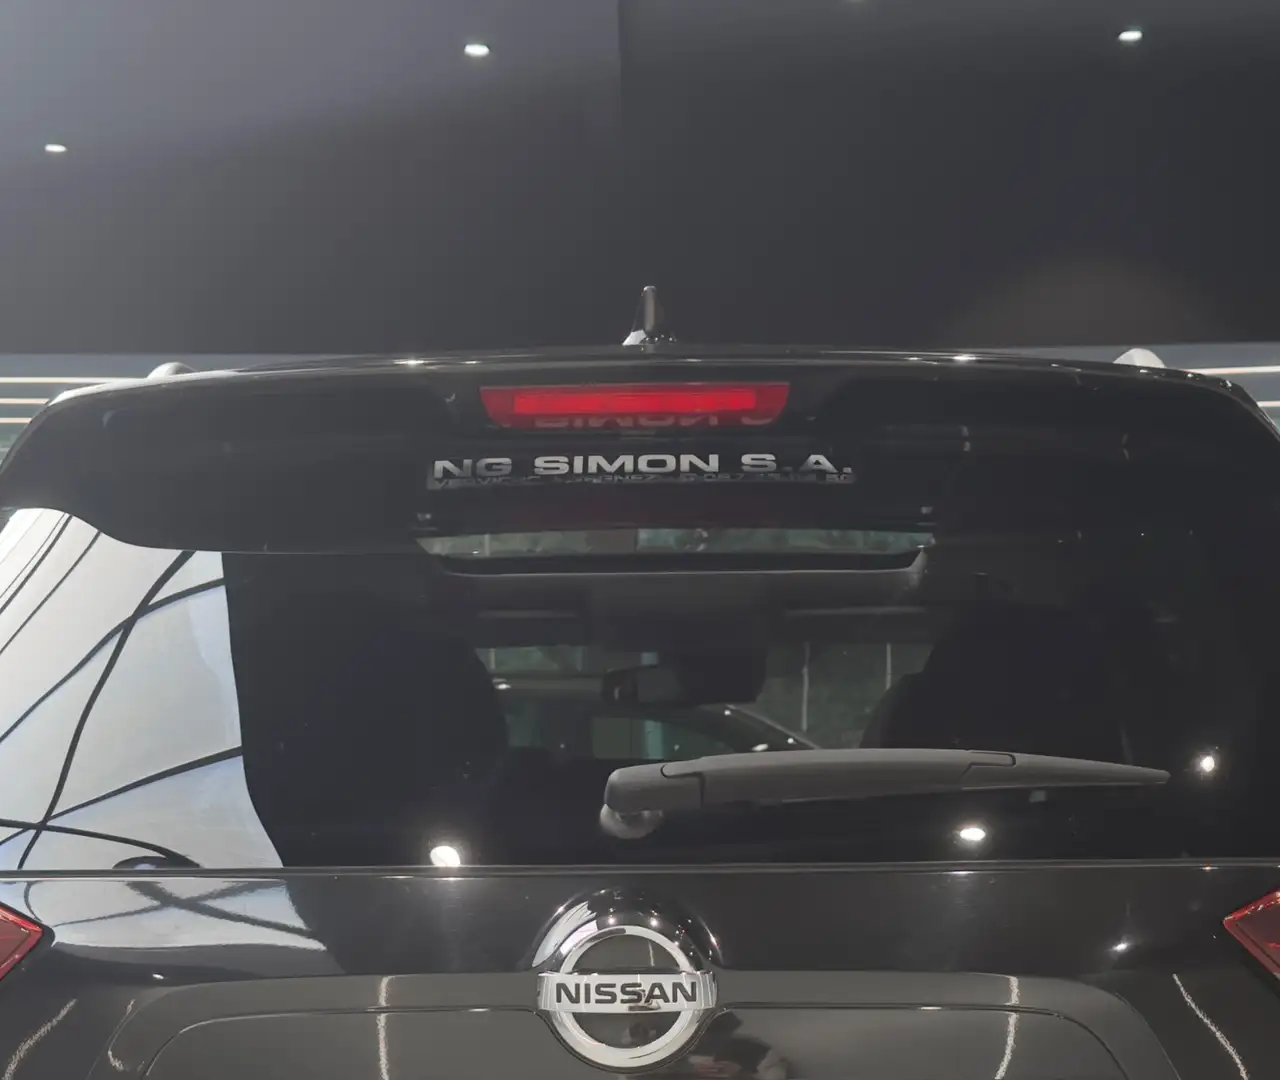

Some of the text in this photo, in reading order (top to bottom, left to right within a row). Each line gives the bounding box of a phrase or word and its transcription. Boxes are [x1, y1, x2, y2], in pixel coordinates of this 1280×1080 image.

[434, 453, 853, 479] NG SIMON S.A.
[555, 981, 698, 1005] NISSAN
